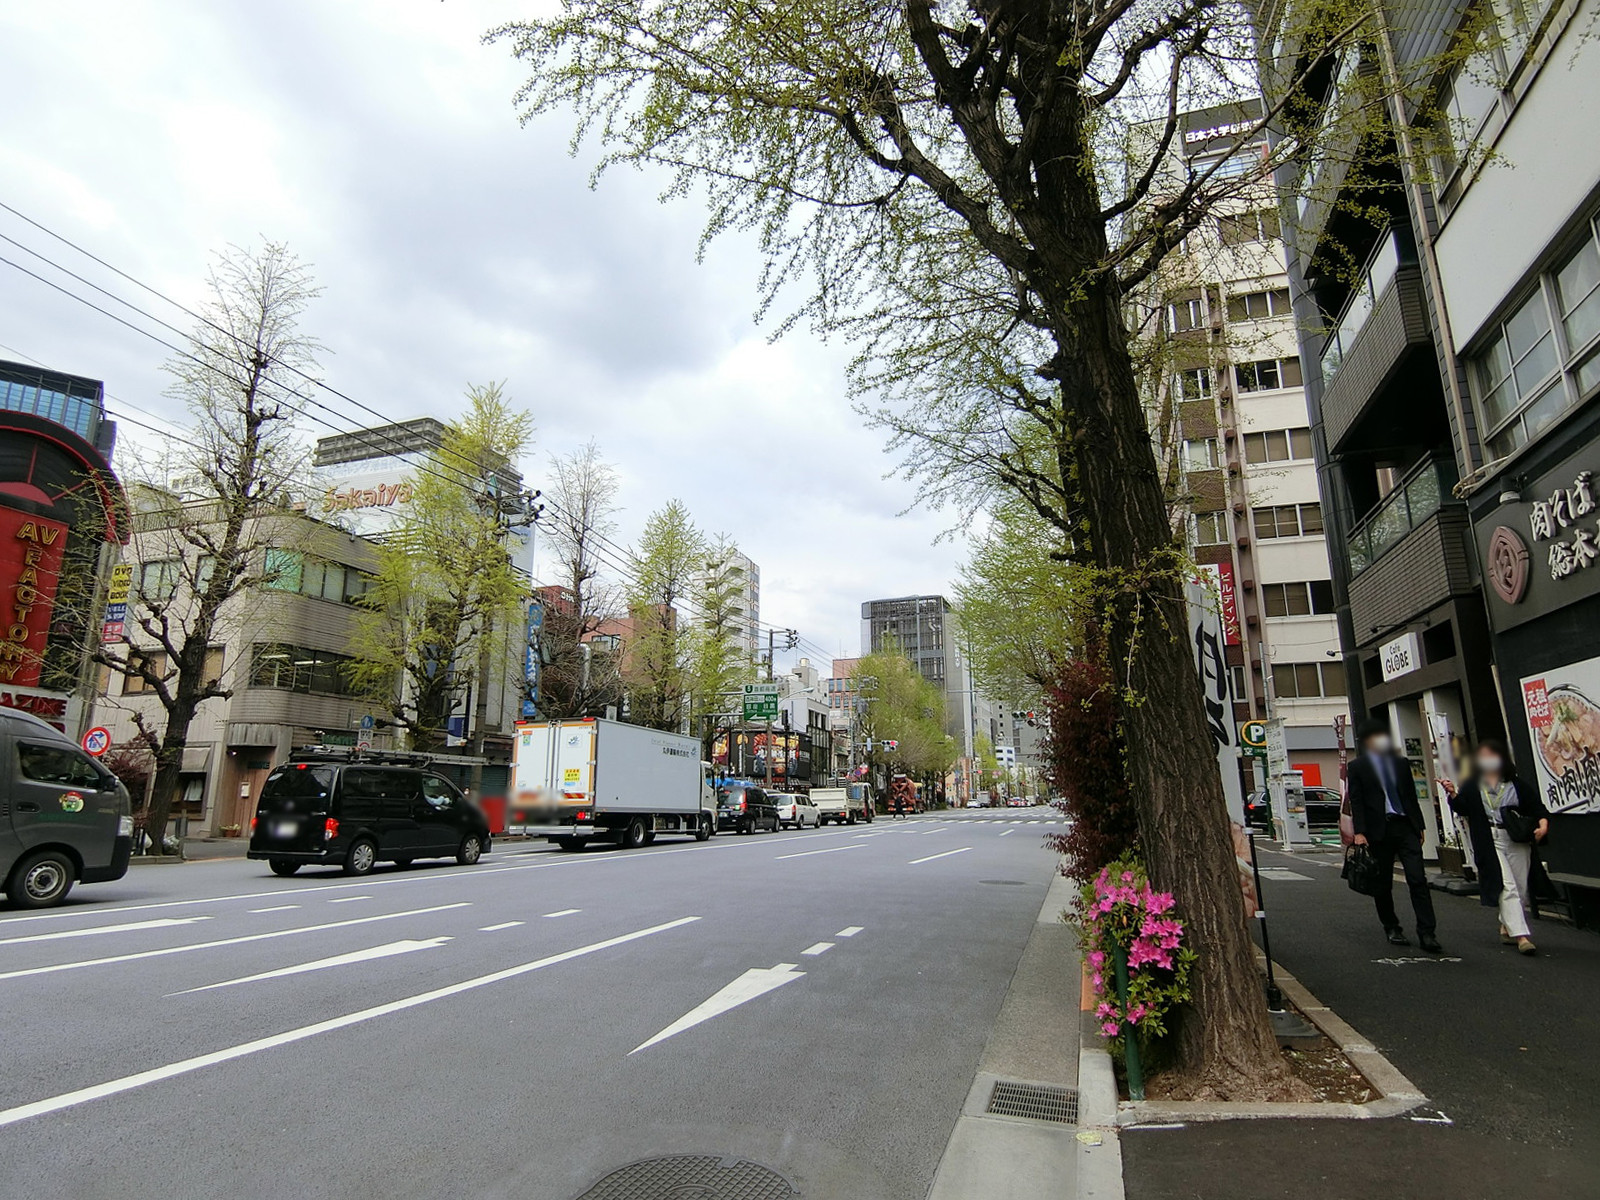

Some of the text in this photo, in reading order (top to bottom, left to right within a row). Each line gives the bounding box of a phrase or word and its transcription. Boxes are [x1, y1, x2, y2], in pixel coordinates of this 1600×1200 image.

[321, 482, 413, 513] Sakaiya
[1530, 470, 1596, 542] 肉そば
[16, 520, 60, 545] AV
[1548, 518, 1600, 581] 総本
[1220, 571, 1238, 637] ビルディング
[1385, 650, 1409, 674] GLOBE
[1527, 688, 1548, 706] 元祖
[1250, 725, 1264, 742] P
